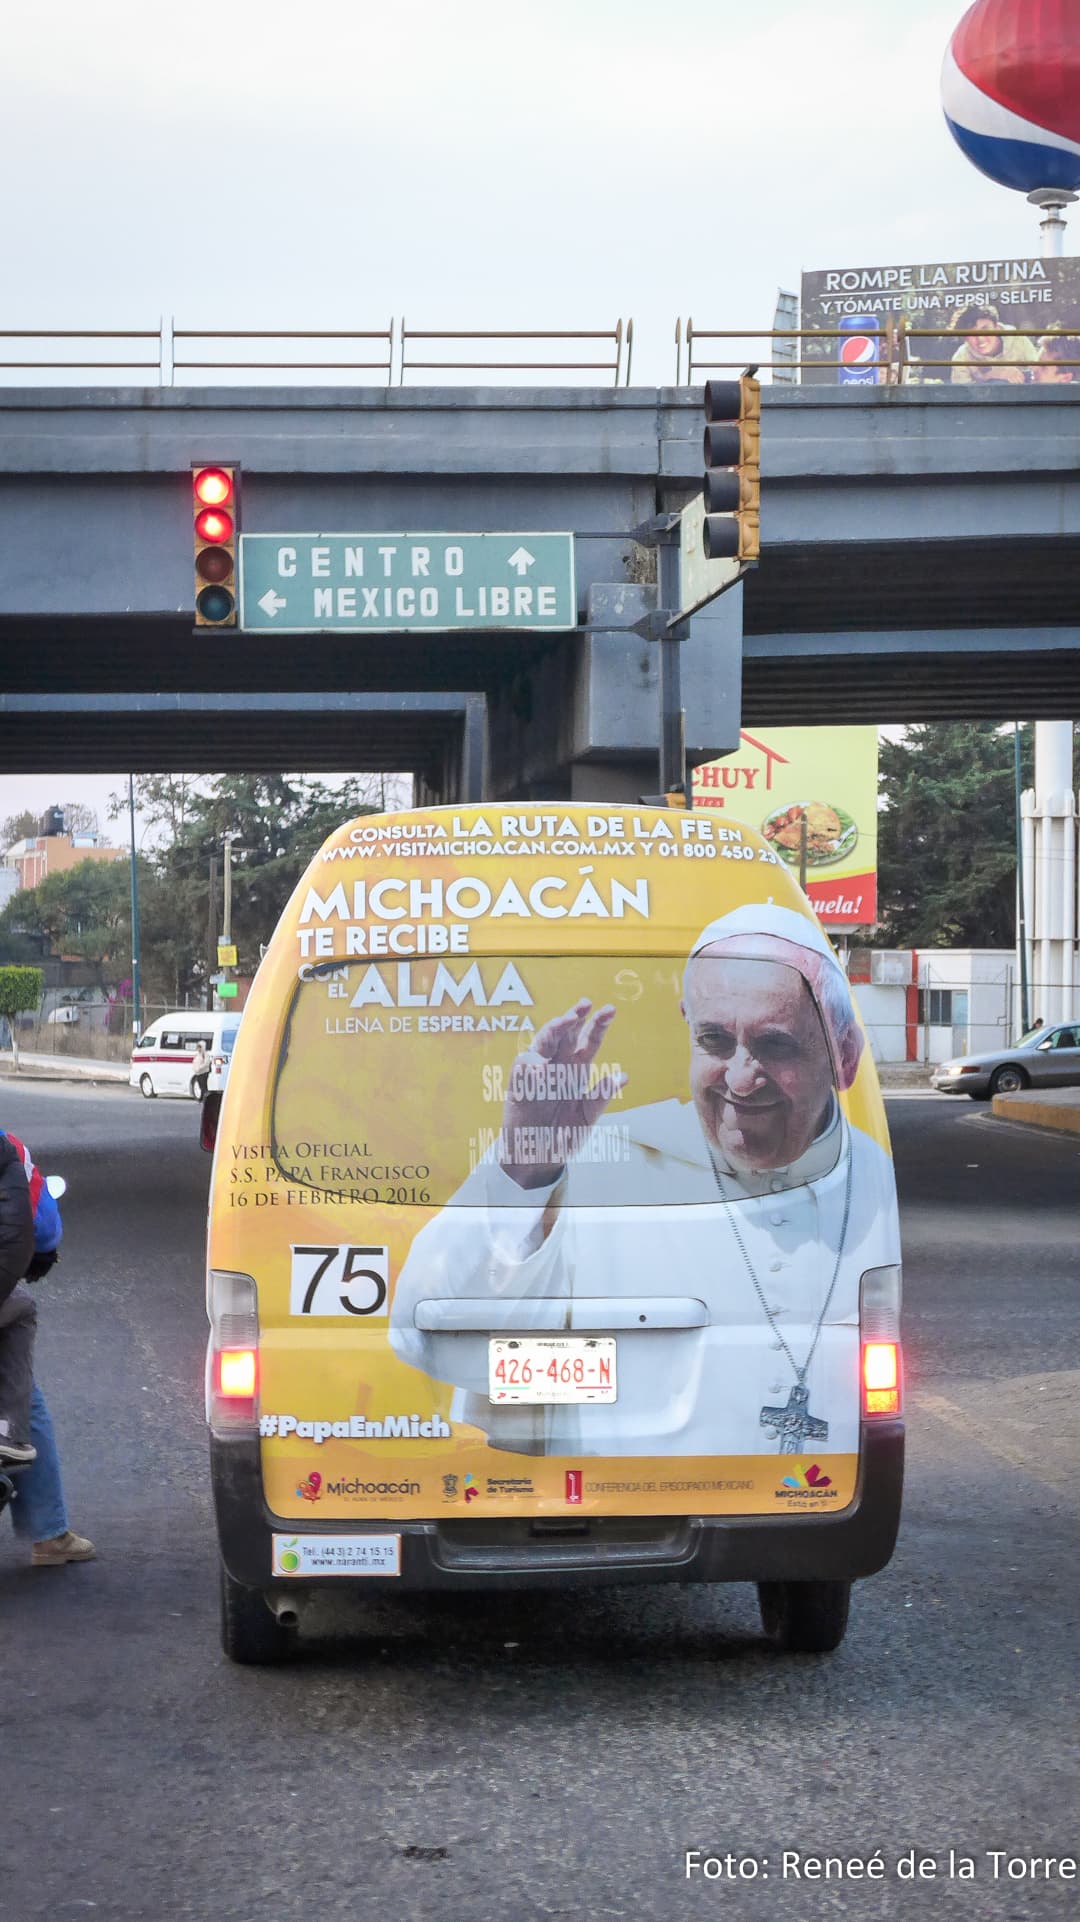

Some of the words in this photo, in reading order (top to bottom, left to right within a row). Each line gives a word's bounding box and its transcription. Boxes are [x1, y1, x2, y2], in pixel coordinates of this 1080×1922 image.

[826, 268, 912, 291] ROMPE
[920, 267, 949, 286] LA
[956, 260, 1046, 284] RUTINA
[820, 302, 832, 314] Y
[834, 296, 902, 314] TÓMATE
[907, 295, 941, 310] UNA
[1000, 289, 1053, 305] SELFIE
[277, 545, 465, 578] CENTRO
[314, 586, 440, 618] MEXICO
[455, 585, 557, 617] LIBRE
[349, 825, 447, 843] CONSULTA
[453, 816, 494, 838] LA
[501, 816, 580, 838] RUTA
[587, 816, 625, 838] DE
[633, 817, 674, 839] LA
[681, 819, 714, 841] FE
[719, 828, 742, 842] EN
[321, 840, 636, 863] WWW.VISITMICHOACAN.COM.MX
[640, 842, 653, 857] Y
[658, 843, 679, 857] 01
[683, 843, 717, 859] 800
[721, 845, 754, 860] 450
[298, 866, 649, 925] MICHOACÁN
[807, 894, 863, 914] uela!
[296, 927, 335, 957] TE
[346, 924, 470, 955] RECIBE
[328, 983, 348, 999] EL
[349, 959, 536, 1008] ALMA
[326, 1016, 385, 1034] LLENA
[389, 1016, 413, 1033] DE
[418, 1015, 535, 1033] ESPERANZA
[482, 1063, 508, 1103] SR.
[512, 1062, 624, 1102] GOBERNADOR
[230, 1167, 258, 1184] S.S.
[265, 1166, 313, 1182] PAPA
[229, 1191, 248, 1207] 16
[254, 1192, 280, 1207] DE
[287, 1188, 379, 1206] FEBRERO
[385, 1187, 431, 1204] 2016
[293, 1246, 387, 1316] 75
[495, 1357, 611, 1384] 426-468-N
[259, 1414, 451, 1443] #PapaEnMich
[327, 1477, 421, 1496] Michoacán
[643, 1481, 657, 1492] DEL
